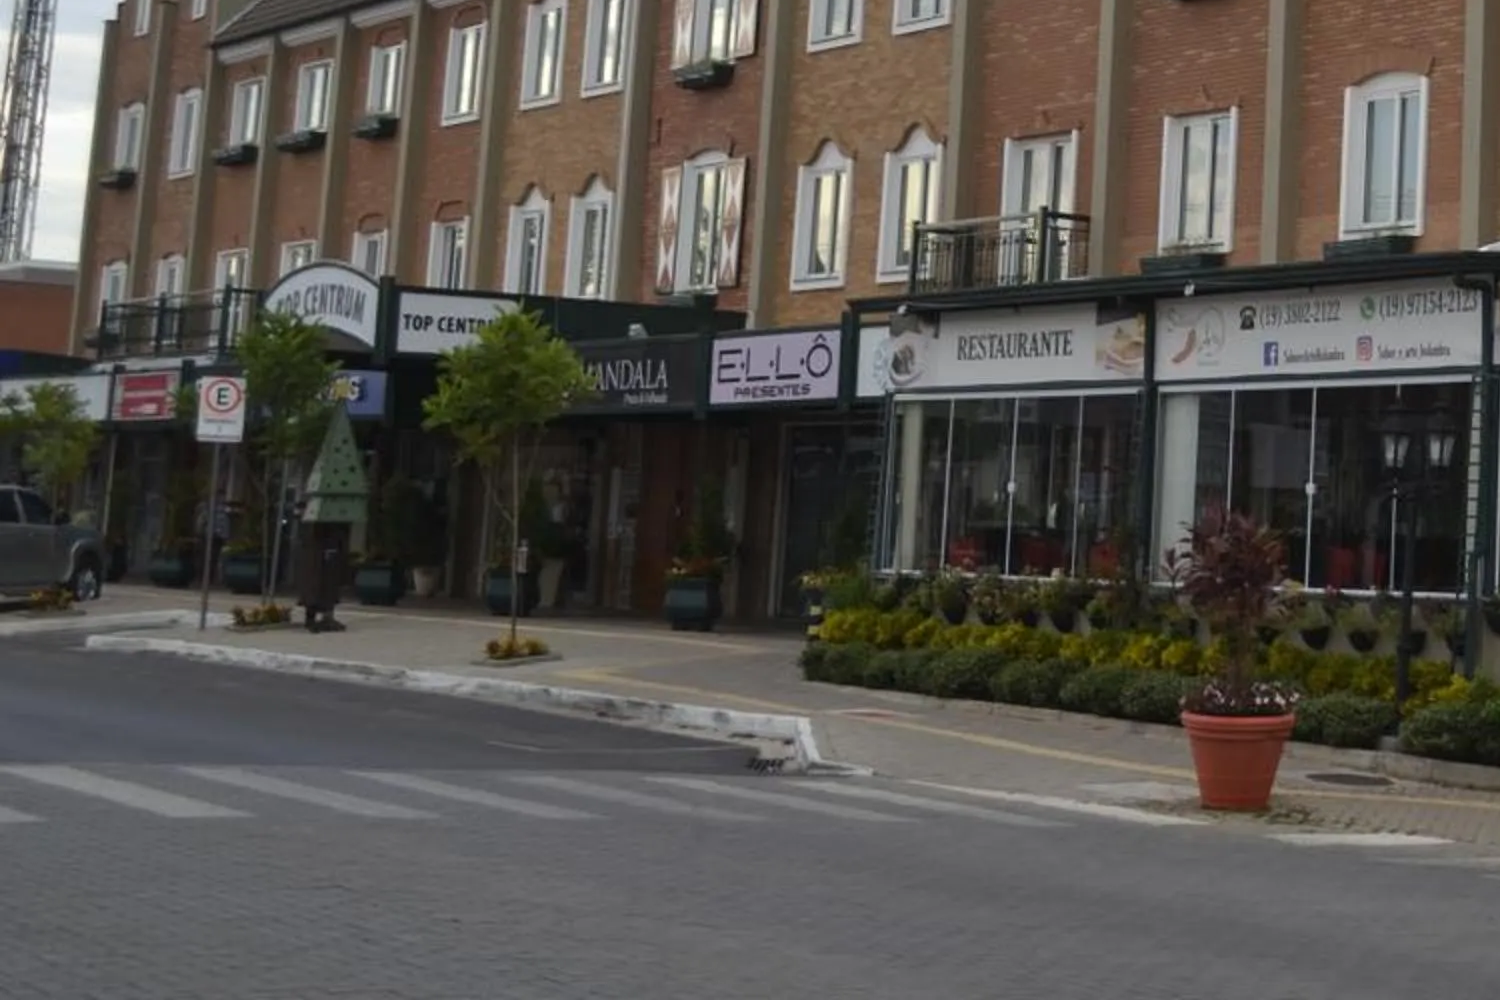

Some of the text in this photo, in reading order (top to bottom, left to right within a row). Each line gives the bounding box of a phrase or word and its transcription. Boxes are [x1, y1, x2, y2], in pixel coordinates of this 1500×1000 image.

[304, 284, 367, 324] CENTRUM
[403, 313, 433, 331] TOP
[957, 329, 1073, 361] RESTAURANTE
[217, 387, 230, 406] E
[733, 383, 813, 399] PRESENTES
